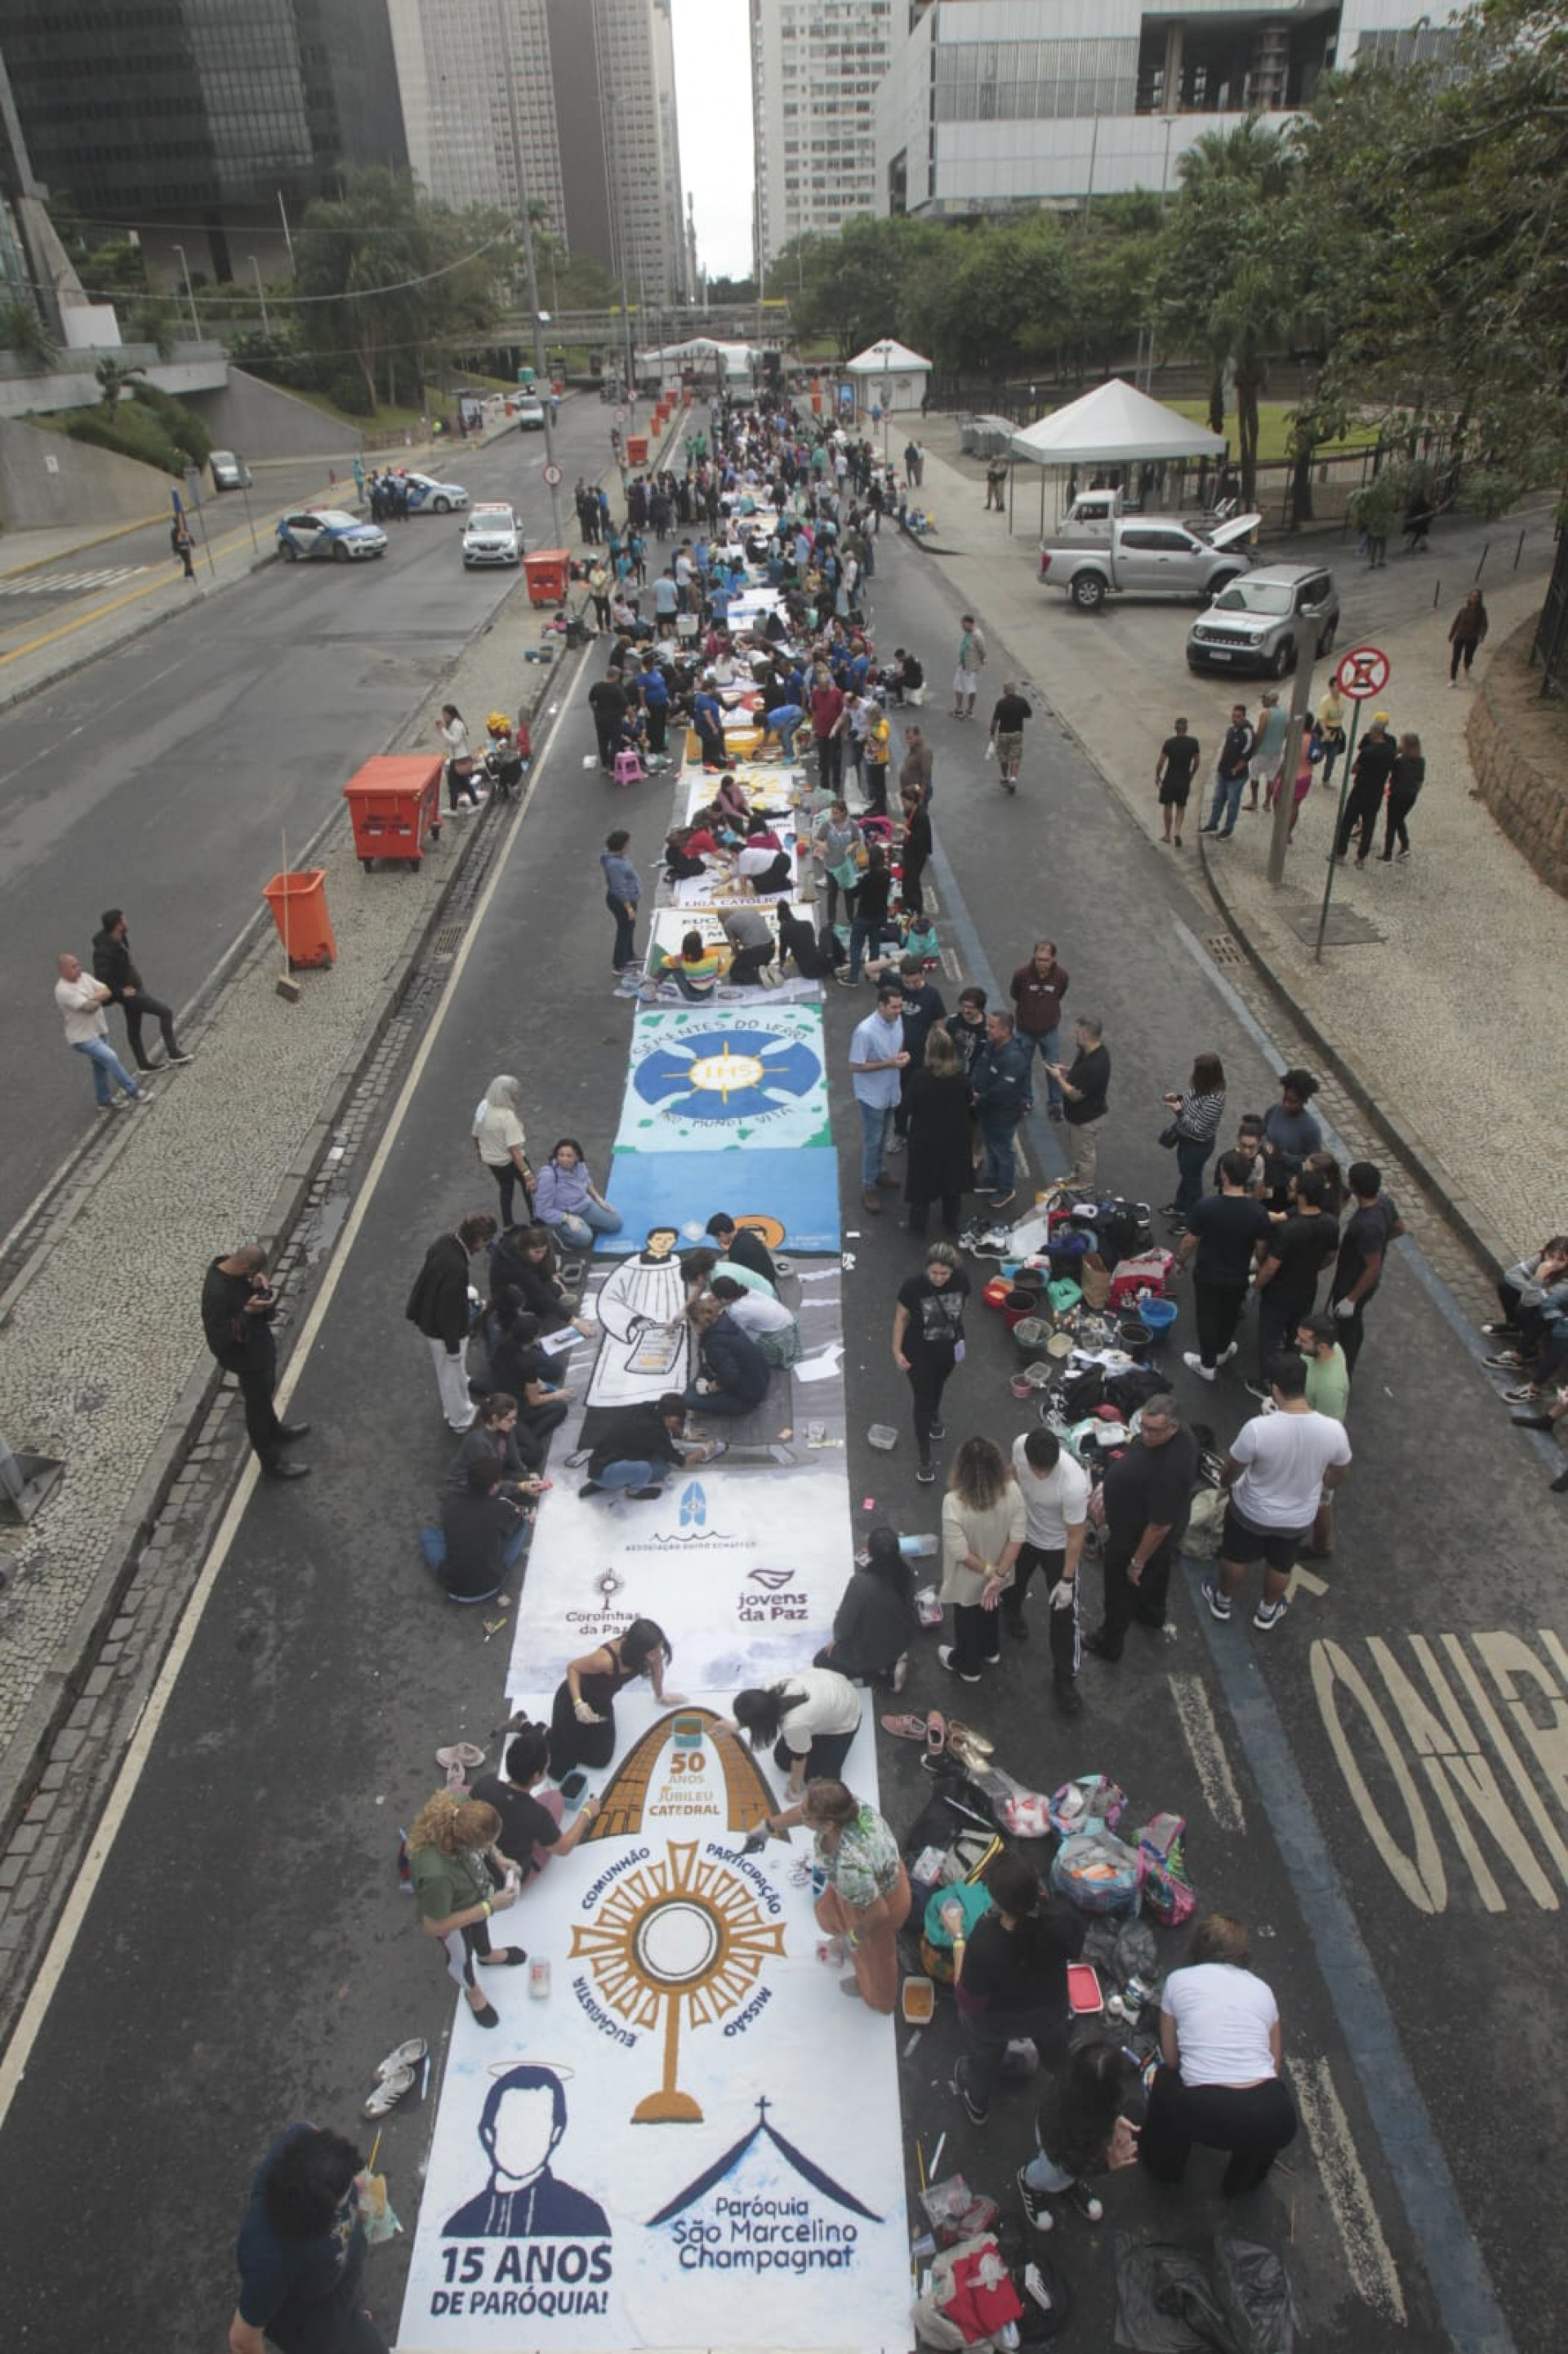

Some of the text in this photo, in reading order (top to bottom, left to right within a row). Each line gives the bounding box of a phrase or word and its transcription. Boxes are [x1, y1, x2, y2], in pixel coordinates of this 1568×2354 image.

[735, 1020, 759, 1029] DO
[737, 1592, 808, 1609] jovens
[738, 1606, 808, 1621] da Paz
[579, 1623, 598, 1634] da
[670, 1751, 706, 1774] 50
[669, 1775, 704, 1784] ANOS
[658, 1790, 714, 1802] JUBILEU
[648, 1804, 720, 1816] CATEDRAL
[581, 1847, 650, 1910] COMUNHÃO
[572, 1975, 637, 2048] EUCARISTIA
[715, 2195, 808, 2219] Paróquia
[672, 2218, 858, 2244] São Marcelino
[442, 2241, 612, 2284] 15 ANOS
[679, 2245, 855, 2274] Champagnat
[430, 2285, 608, 2317] DE PARÓQUIA!
